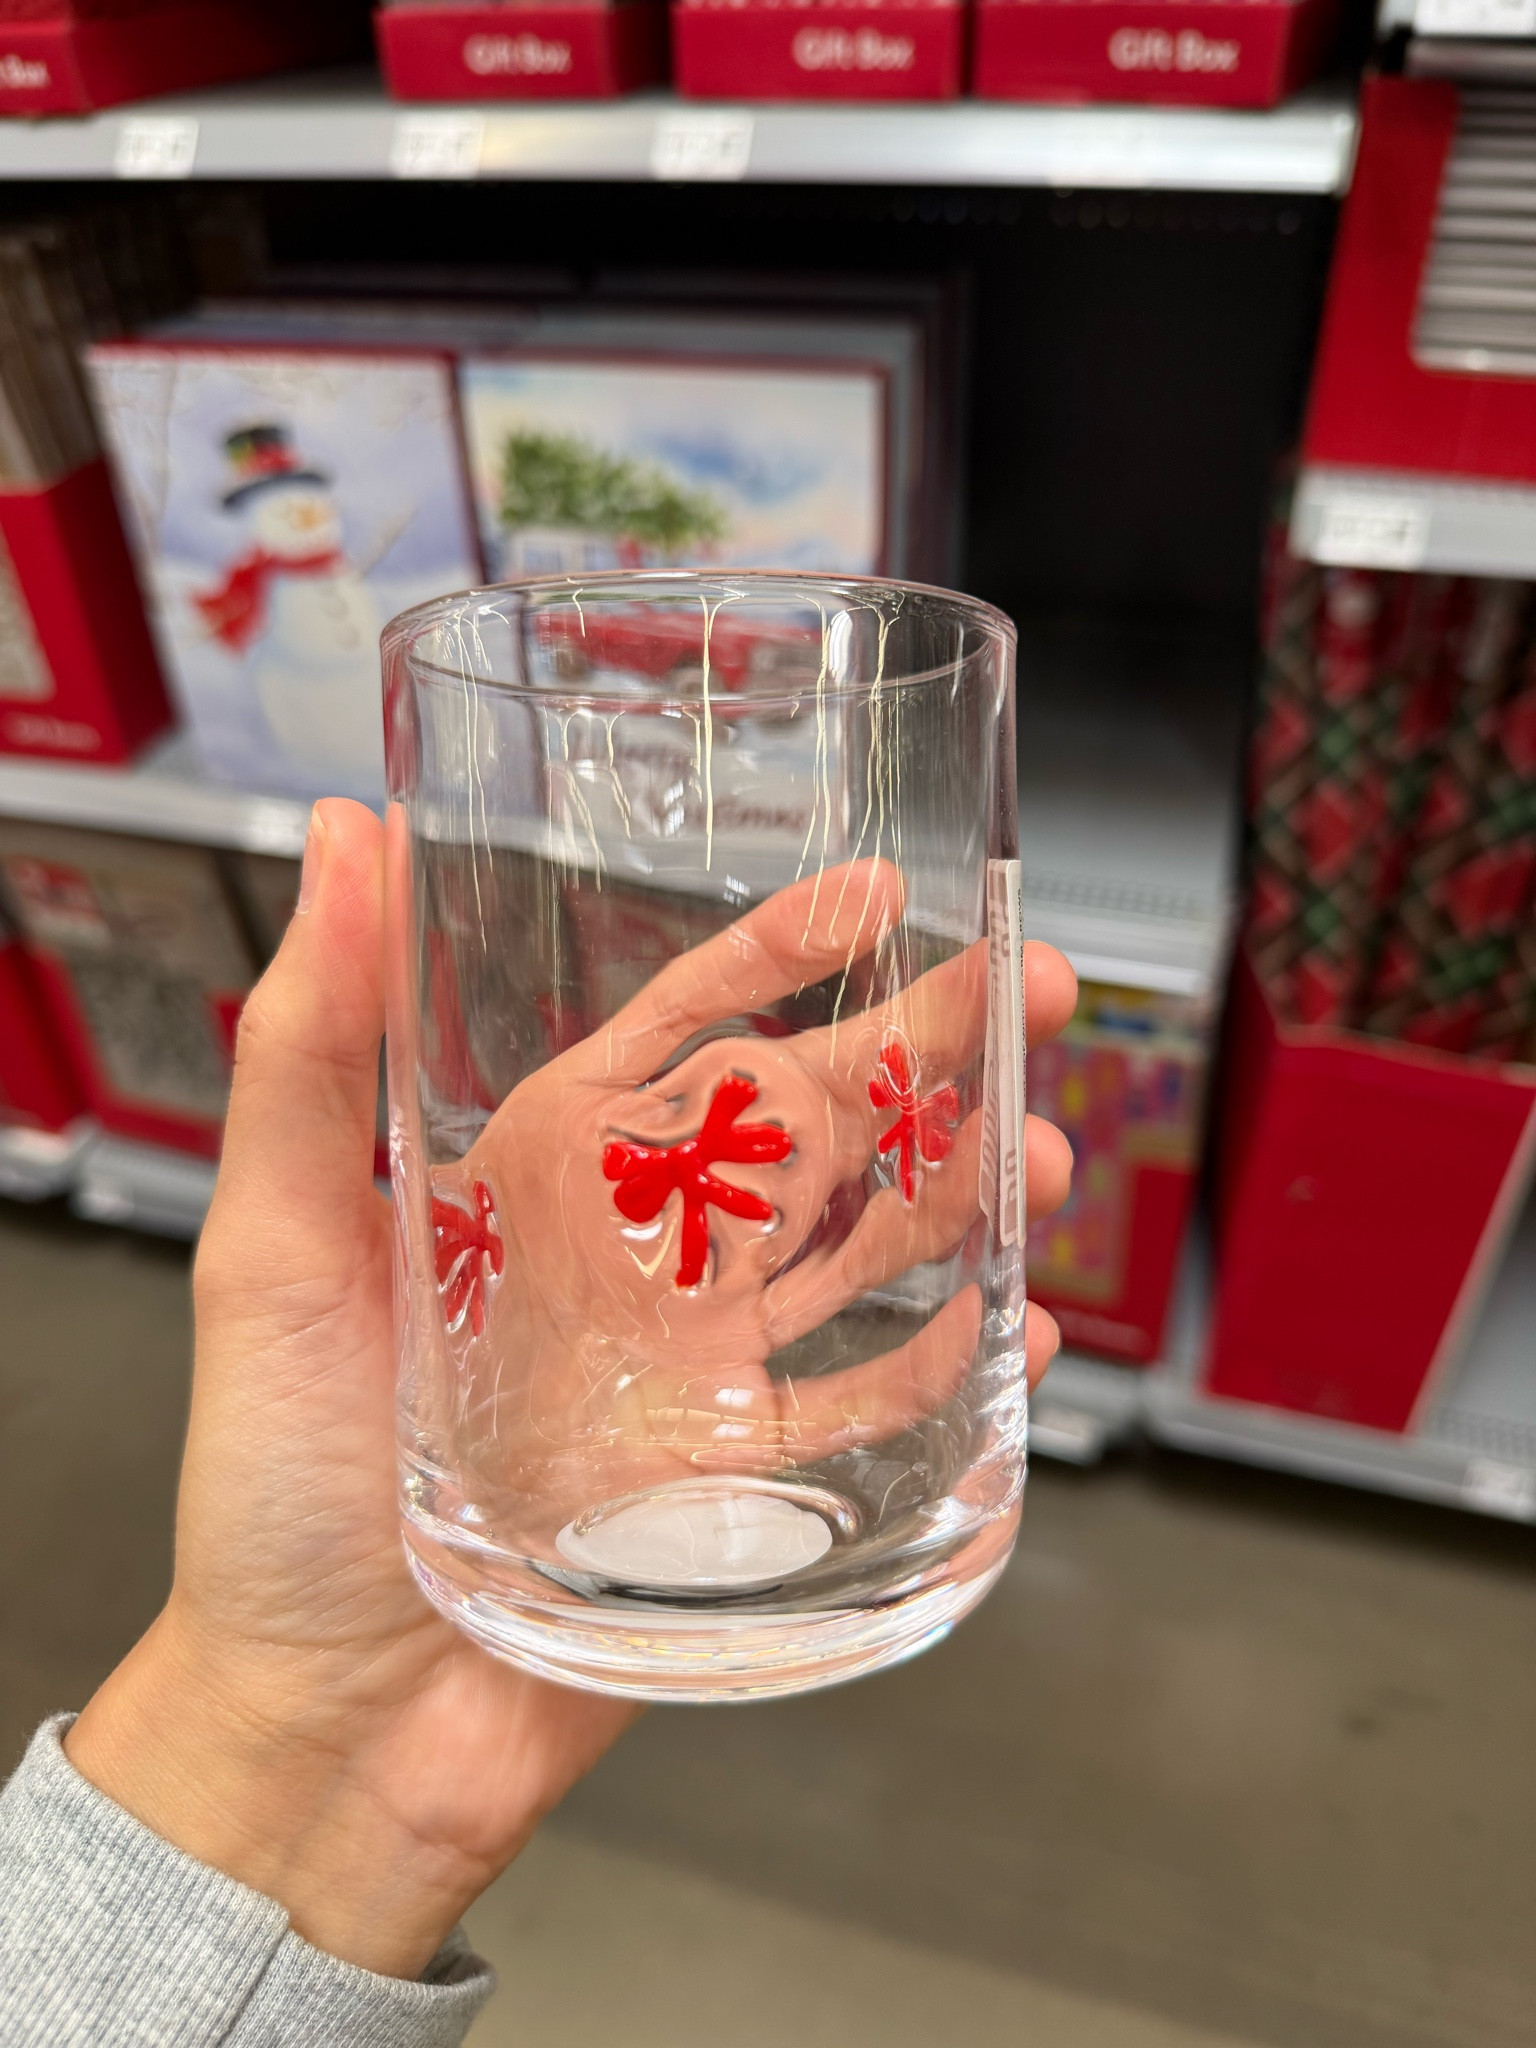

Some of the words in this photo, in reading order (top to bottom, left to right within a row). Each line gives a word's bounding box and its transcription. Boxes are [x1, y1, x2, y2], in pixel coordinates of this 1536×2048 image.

[519, 33, 572, 74] Box
[793, 27, 854, 70] Gift
[856, 27, 916, 70] Box
[1108, 28, 1171, 71] Gift
[1177, 29, 1240, 72] Box
